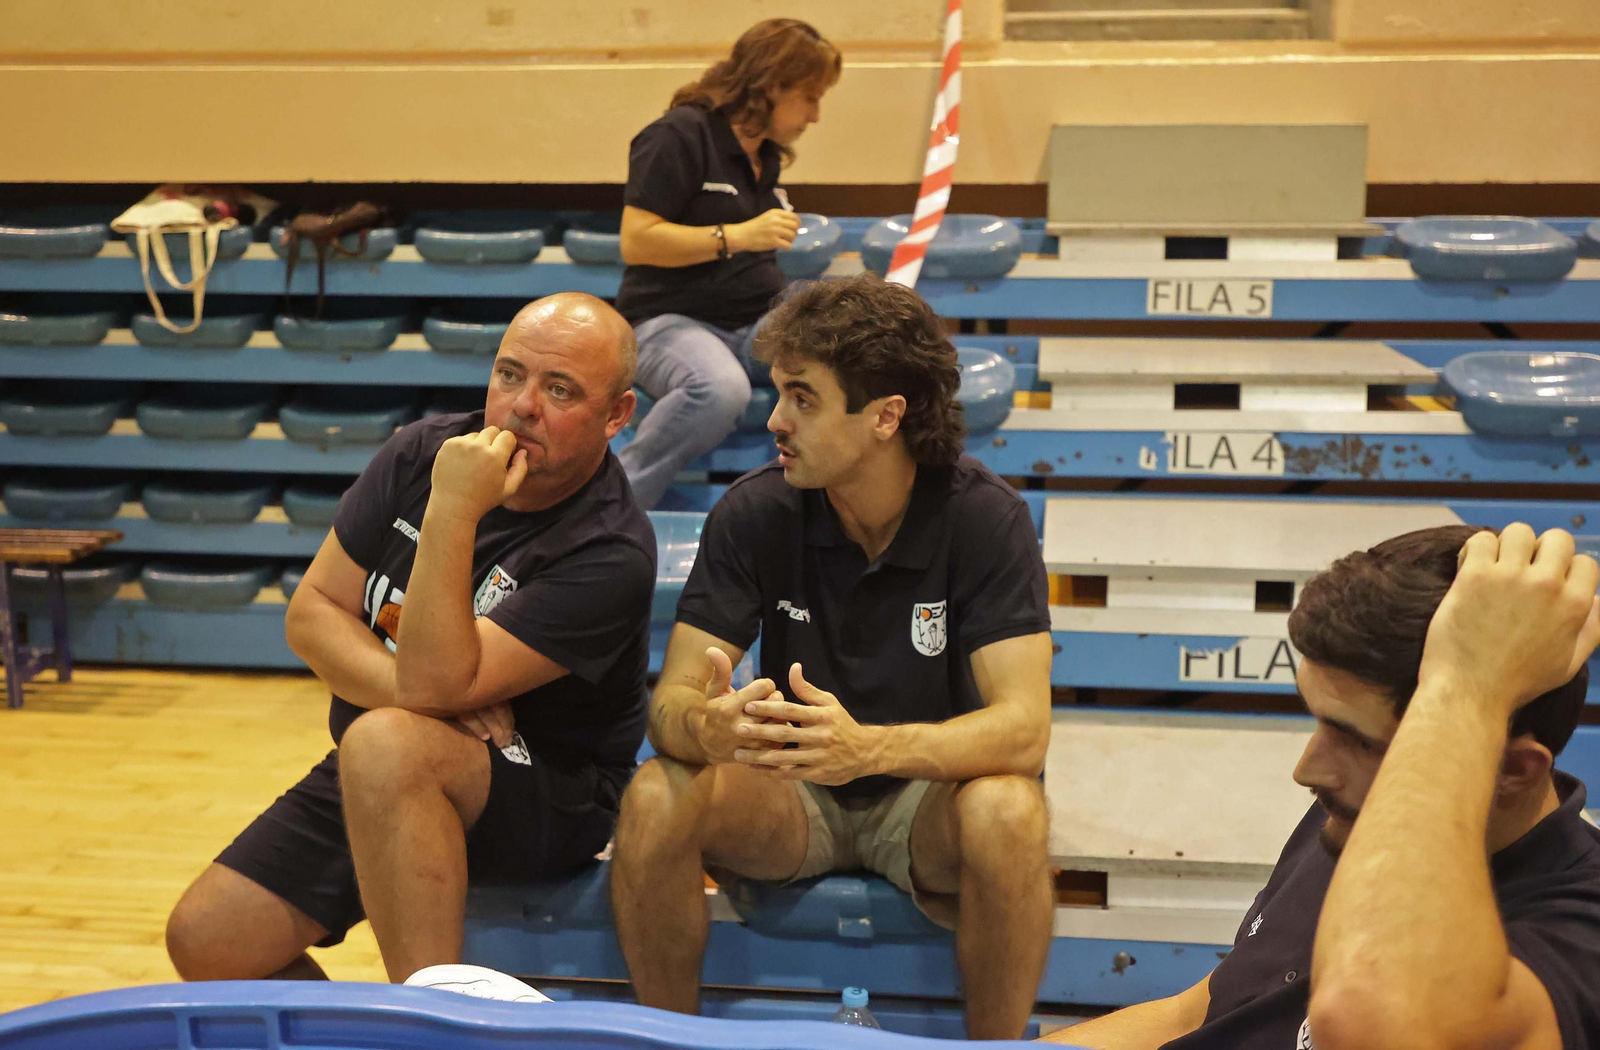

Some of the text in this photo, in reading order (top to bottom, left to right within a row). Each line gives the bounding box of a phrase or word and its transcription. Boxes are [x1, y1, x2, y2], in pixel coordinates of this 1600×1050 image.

[1152, 280, 1267, 315] FILA 5
[1146, 435, 1278, 471] ILA 4
